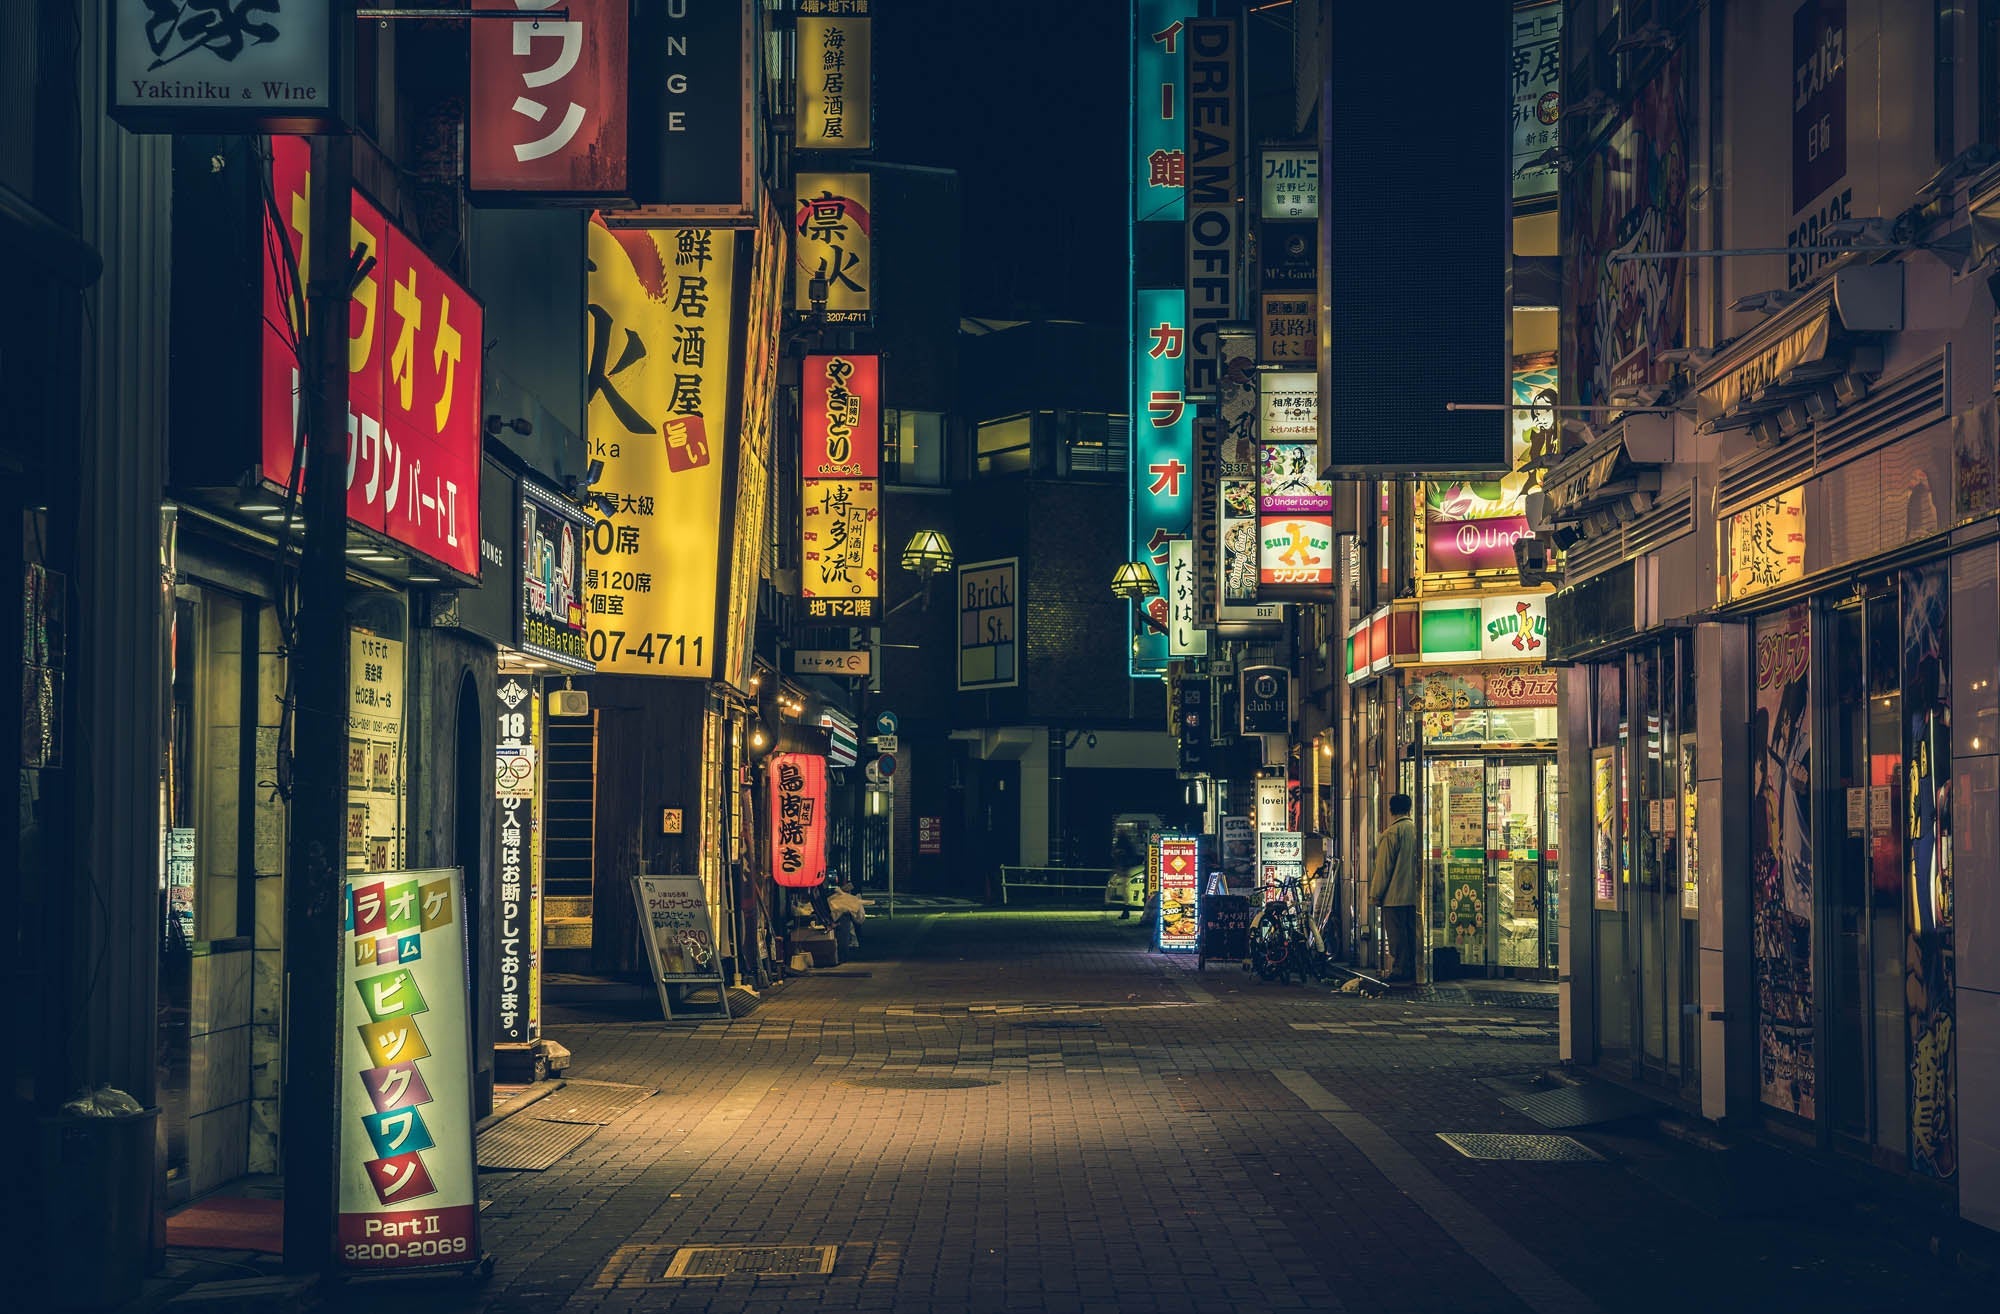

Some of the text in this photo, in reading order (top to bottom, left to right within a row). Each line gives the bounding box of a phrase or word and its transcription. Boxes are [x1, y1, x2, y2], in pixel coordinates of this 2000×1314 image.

[1796, 25, 1844, 112] エスパス
[133, 80, 317, 99] Yakiniku & Wine
[512, 0, 586, 161] ワン
[821, 27, 846, 139] 海鮮居酒屋
[1276, 182, 1316, 192] 近野ビル
[1290, 208, 1303, 216] 6F
[827, 358, 853, 463] やきとり
[1300, 499, 1328, 508] Lounge
[849, 511, 863, 564] 九州酒場
[481, 538, 503, 567] OUNGE
[1273, 569, 1320, 583] サンクス
[967, 577, 1009, 610] Brick
[810, 599, 871, 617] 地下2階
[1256, 607, 1273, 618] B1F
[988, 616, 1008, 643] St.
[585, 629, 704, 667] 07-4711
[1511, 679, 1522, 695] 春
[1247, 700, 1272, 712] club
[357, 940, 419, 961] ルーム
[345, 1237, 466, 1260] 3200-2069
